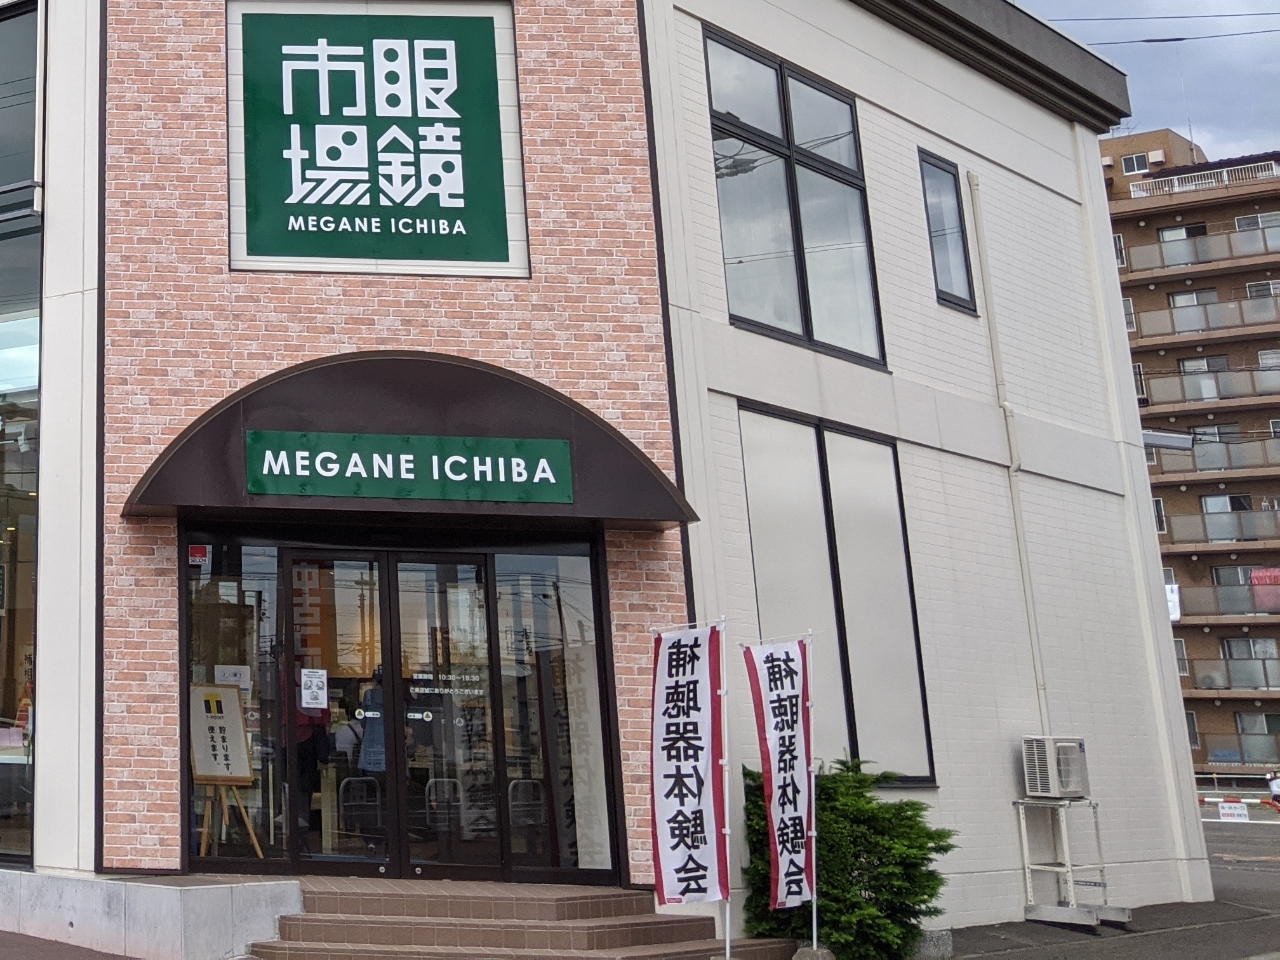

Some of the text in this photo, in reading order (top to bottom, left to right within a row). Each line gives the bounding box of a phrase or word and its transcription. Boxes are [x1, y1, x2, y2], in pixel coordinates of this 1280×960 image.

[288, 215, 468, 235] MEGANE ICHIBA
[262, 448, 556, 485] MEGANE ICHIBA
